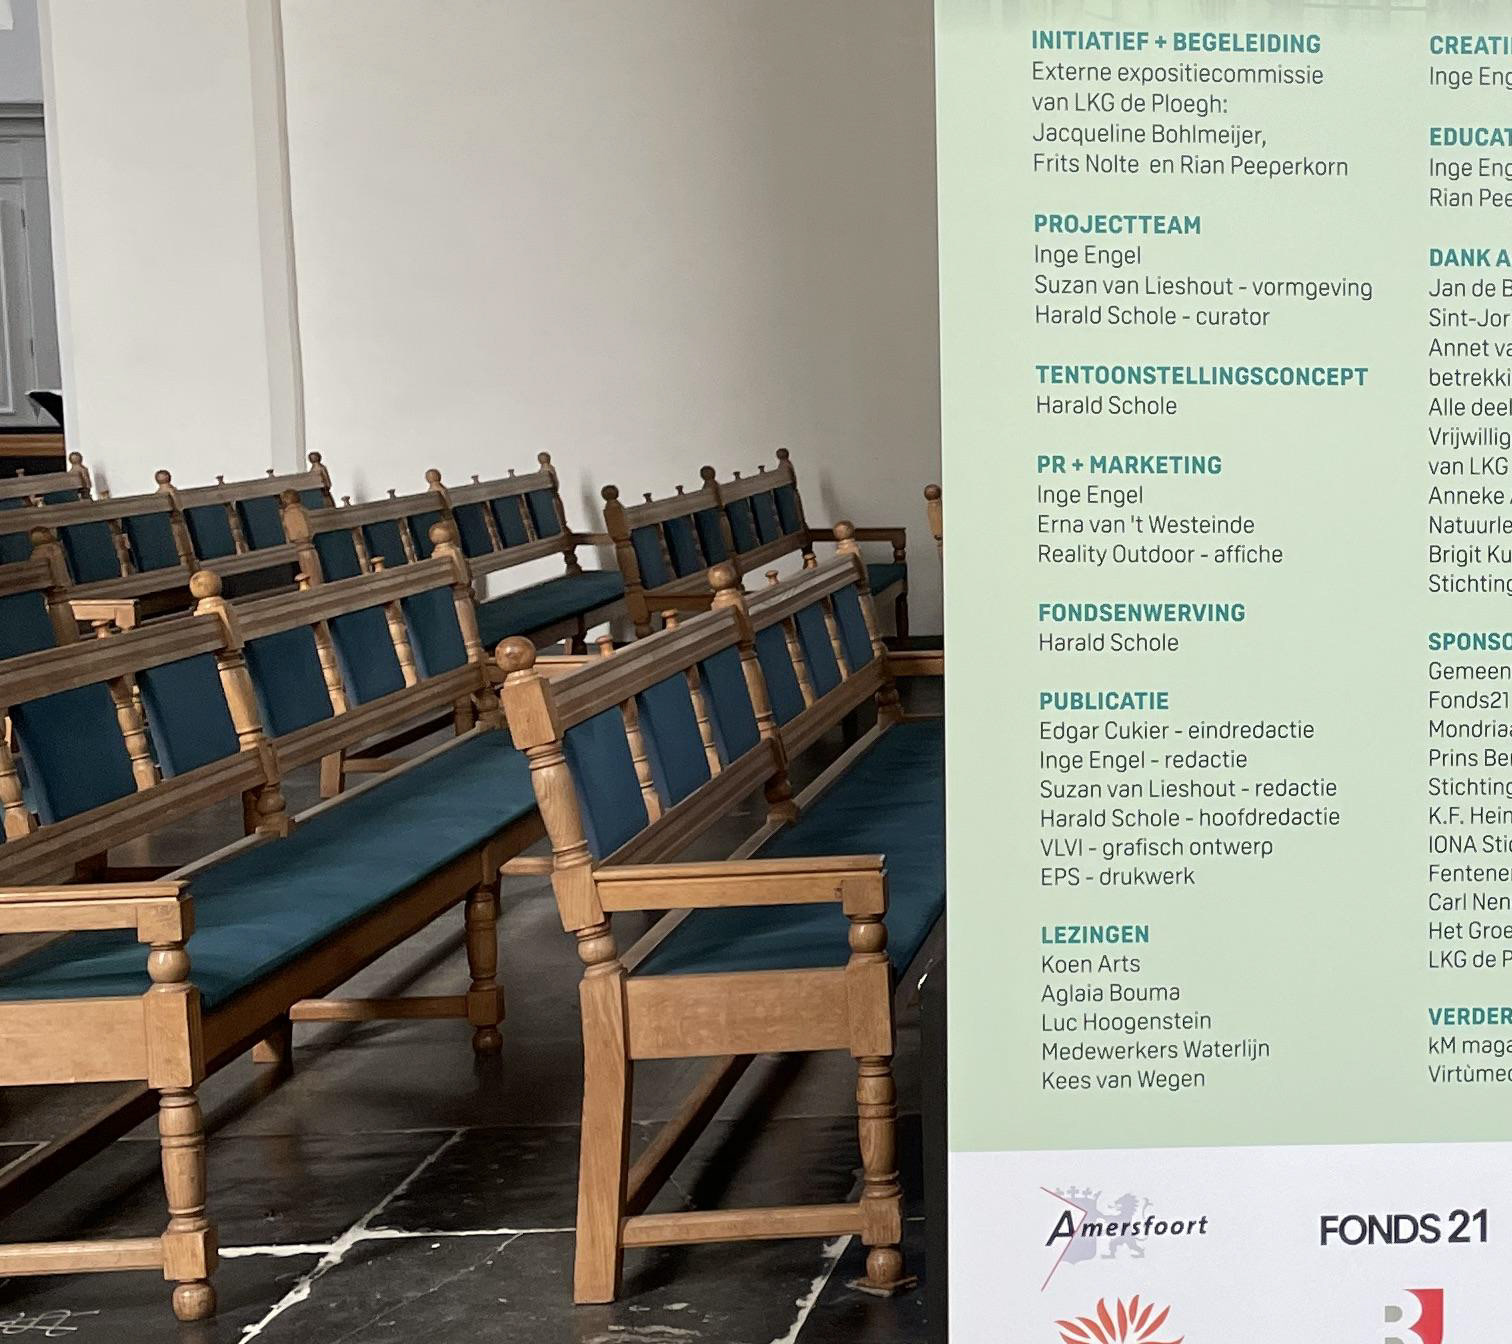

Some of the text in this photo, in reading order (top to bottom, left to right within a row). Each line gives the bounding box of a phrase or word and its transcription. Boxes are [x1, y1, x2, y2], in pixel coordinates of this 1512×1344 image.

[1032, 30, 1149, 51] INITIATIEF
[1174, 32, 1320, 53] BEGELEIDING
[1033, 61, 1323, 86] Externe expositiecommissie
[1033, 122, 1266, 148] Jacqueline Bohlmeijer,
[1034, 153, 1348, 179] Frits Nolte en Rian Peeperkorn
[1430, 188, 1472, 207] Rian
[1035, 214, 1200, 234] PROJECTTEAM
[1035, 244, 1140, 268] Inge Engel
[1430, 248, 1491, 267] DANK
[1429, 338, 1489, 357] Annet
[1035, 365, 1368, 386] TENTOONSTELLINGSCONCEPT
[1037, 395, 1177, 415] Harald Schole
[1428, 398, 1465, 416] Alle
[1038, 455, 1066, 474] PR
[1090, 456, 1221, 474] MARKETING
[1039, 515, 1083, 533] Erna
[1089, 519, 1125, 533] van
[1149, 514, 1254, 534] Westeinde
[1039, 603, 1245, 622] FONDSENWERVING
[1040, 692, 1169, 710] PUBLICATIE
[1430, 691, 1508, 709] Fonds21
[1041, 721, 1099, 744] Edgar
[1105, 721, 1169, 739] Cukier
[1189, 720, 1314, 739] eindredactie
[1430, 807, 1464, 824] K.F.
[1471, 806, 1512, 824] Hein
[1040, 838, 1082, 856] VLVI
[1103, 838, 1183, 860] grafisch
[1190, 838, 1272, 859] ontwerp
[1430, 835, 1477, 853] IONA
[1042, 867, 1079, 886] EPS
[1100, 867, 1195, 885] drukwerk
[1042, 925, 1149, 944] LEZINGEN
[1041, 983, 1179, 1006] Aglaia Bouma
[1043, 1011, 1211, 1034] Luc Hoogenstein
[1043, 1039, 1269, 1061] Medewerkers Waterlijn
[1429, 1036, 1455, 1054] kM
[1046, 1203, 1208, 1246] Amersfoort
[1321, 1209, 1487, 1245] FONDS 21
